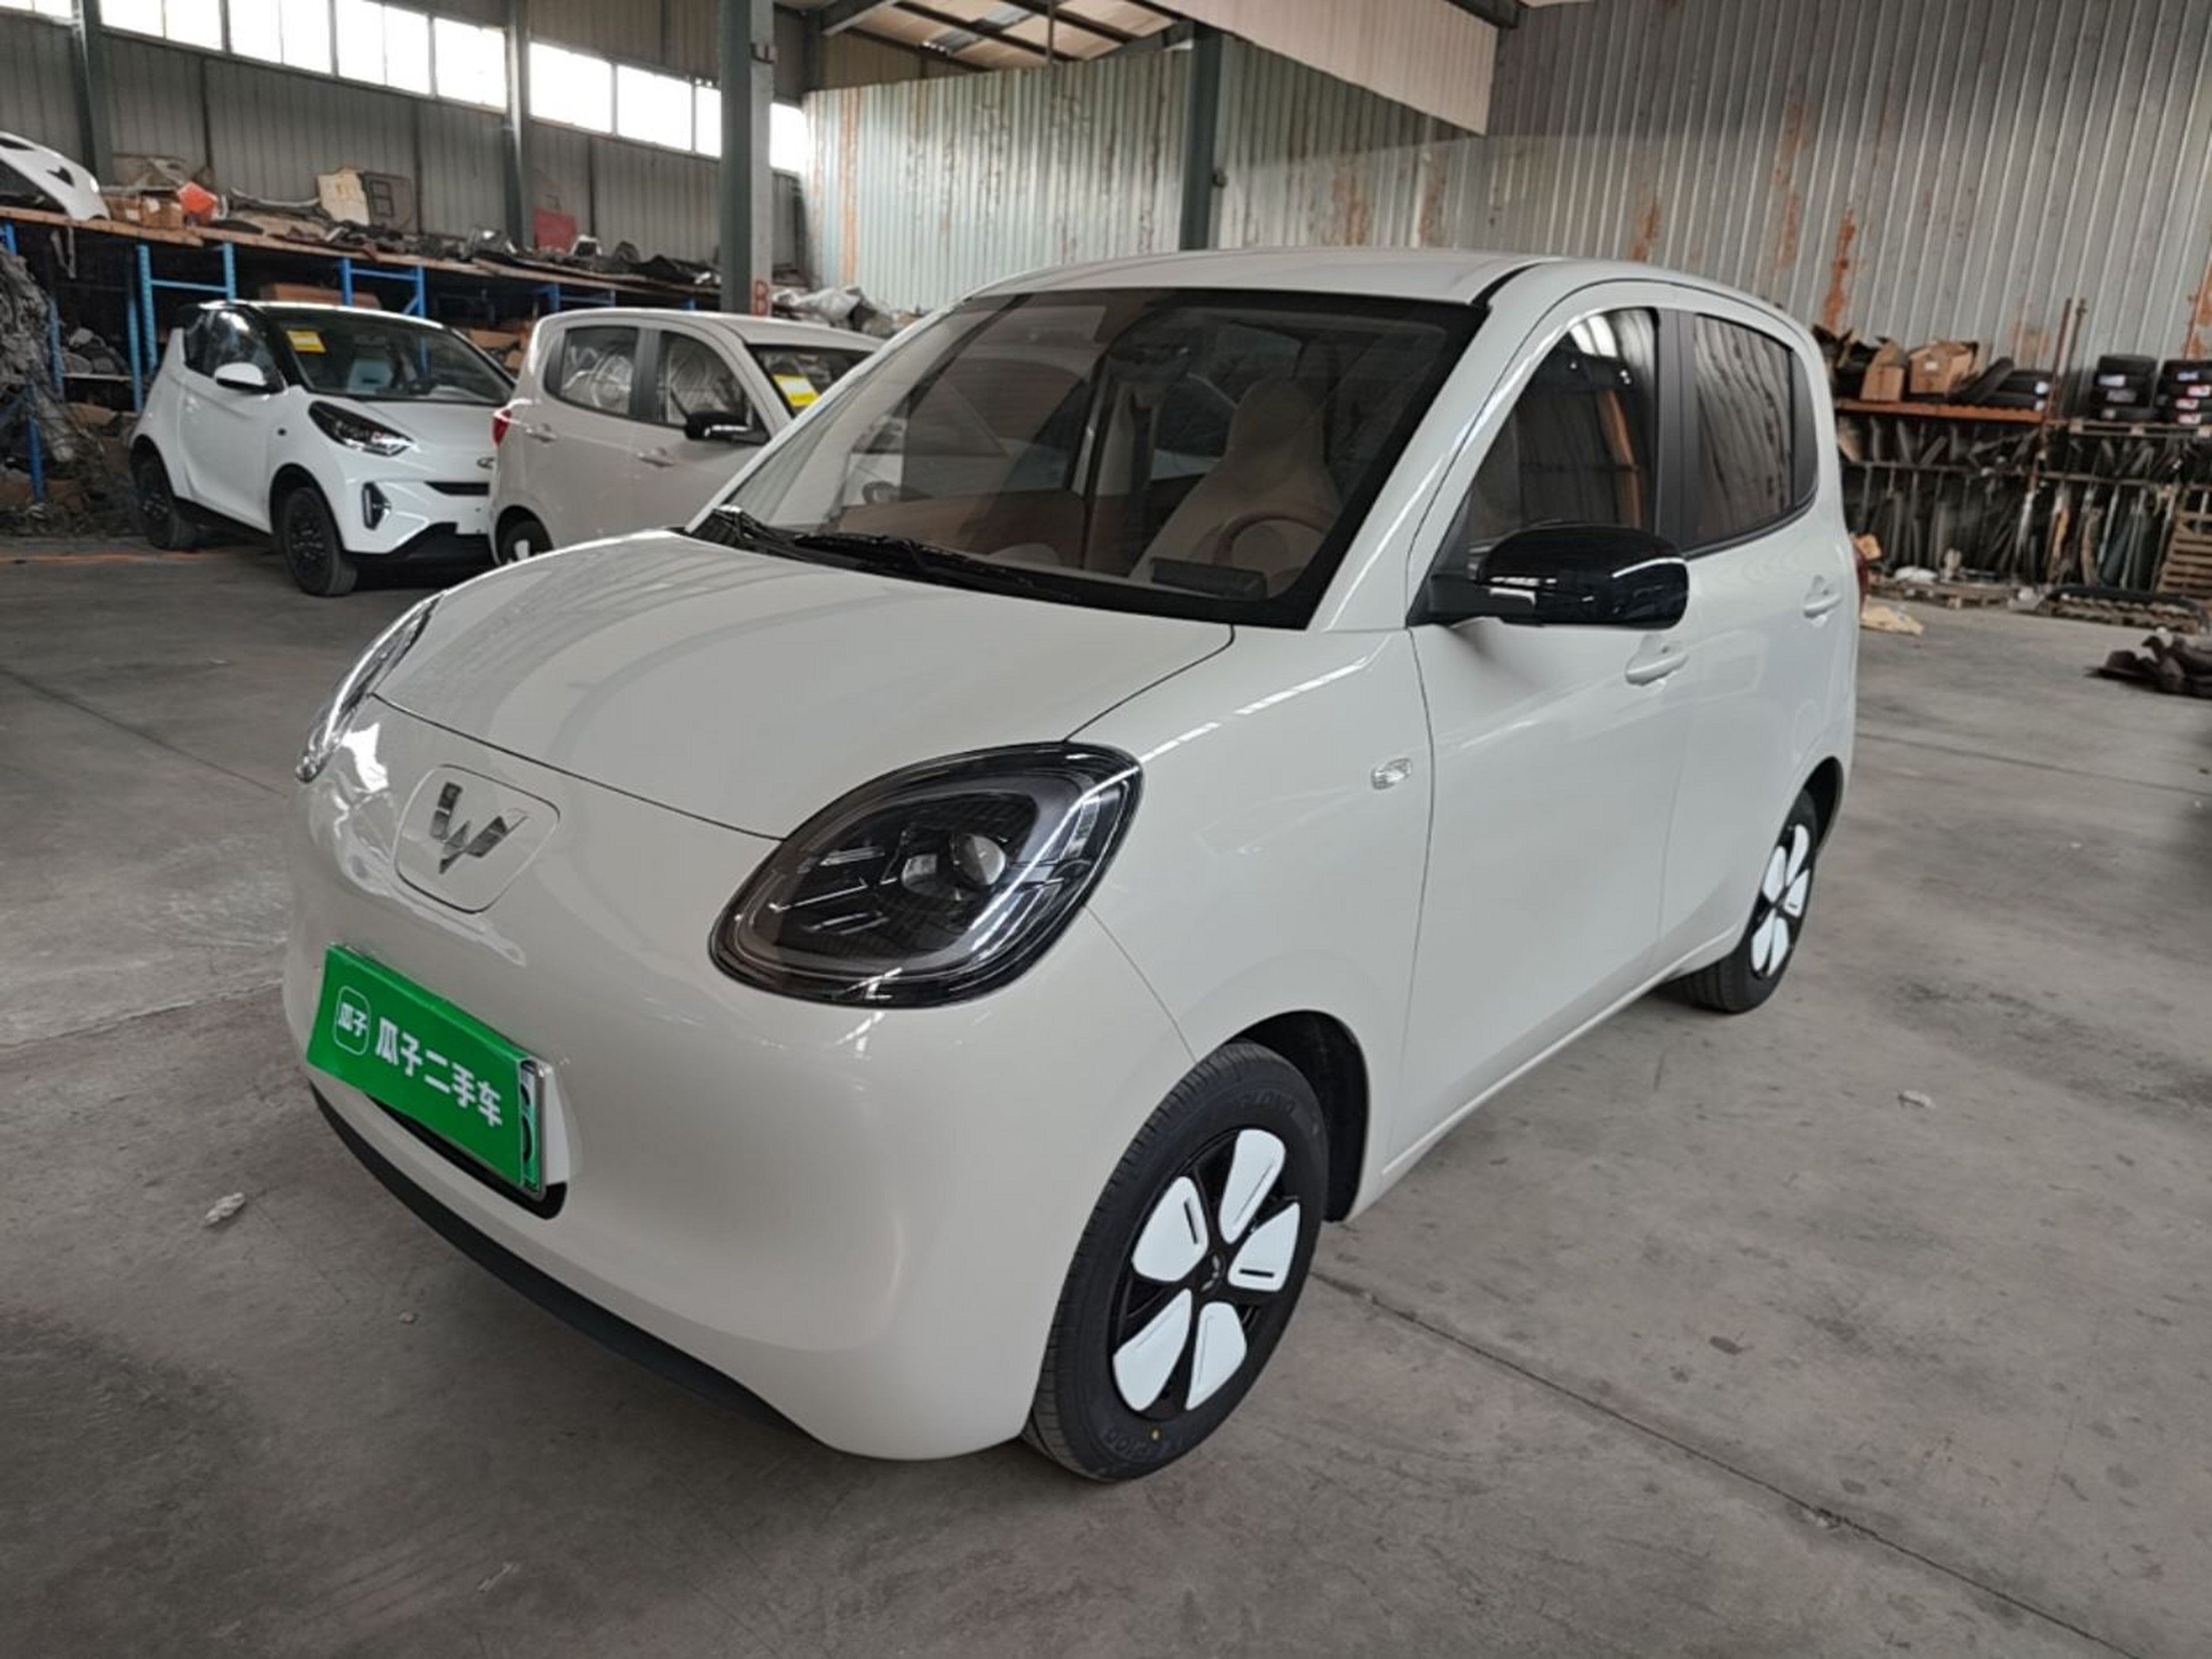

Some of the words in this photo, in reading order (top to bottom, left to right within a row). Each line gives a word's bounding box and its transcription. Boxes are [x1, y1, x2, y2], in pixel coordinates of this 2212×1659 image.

[375, 1017, 503, 1128] 瓜子二手车
